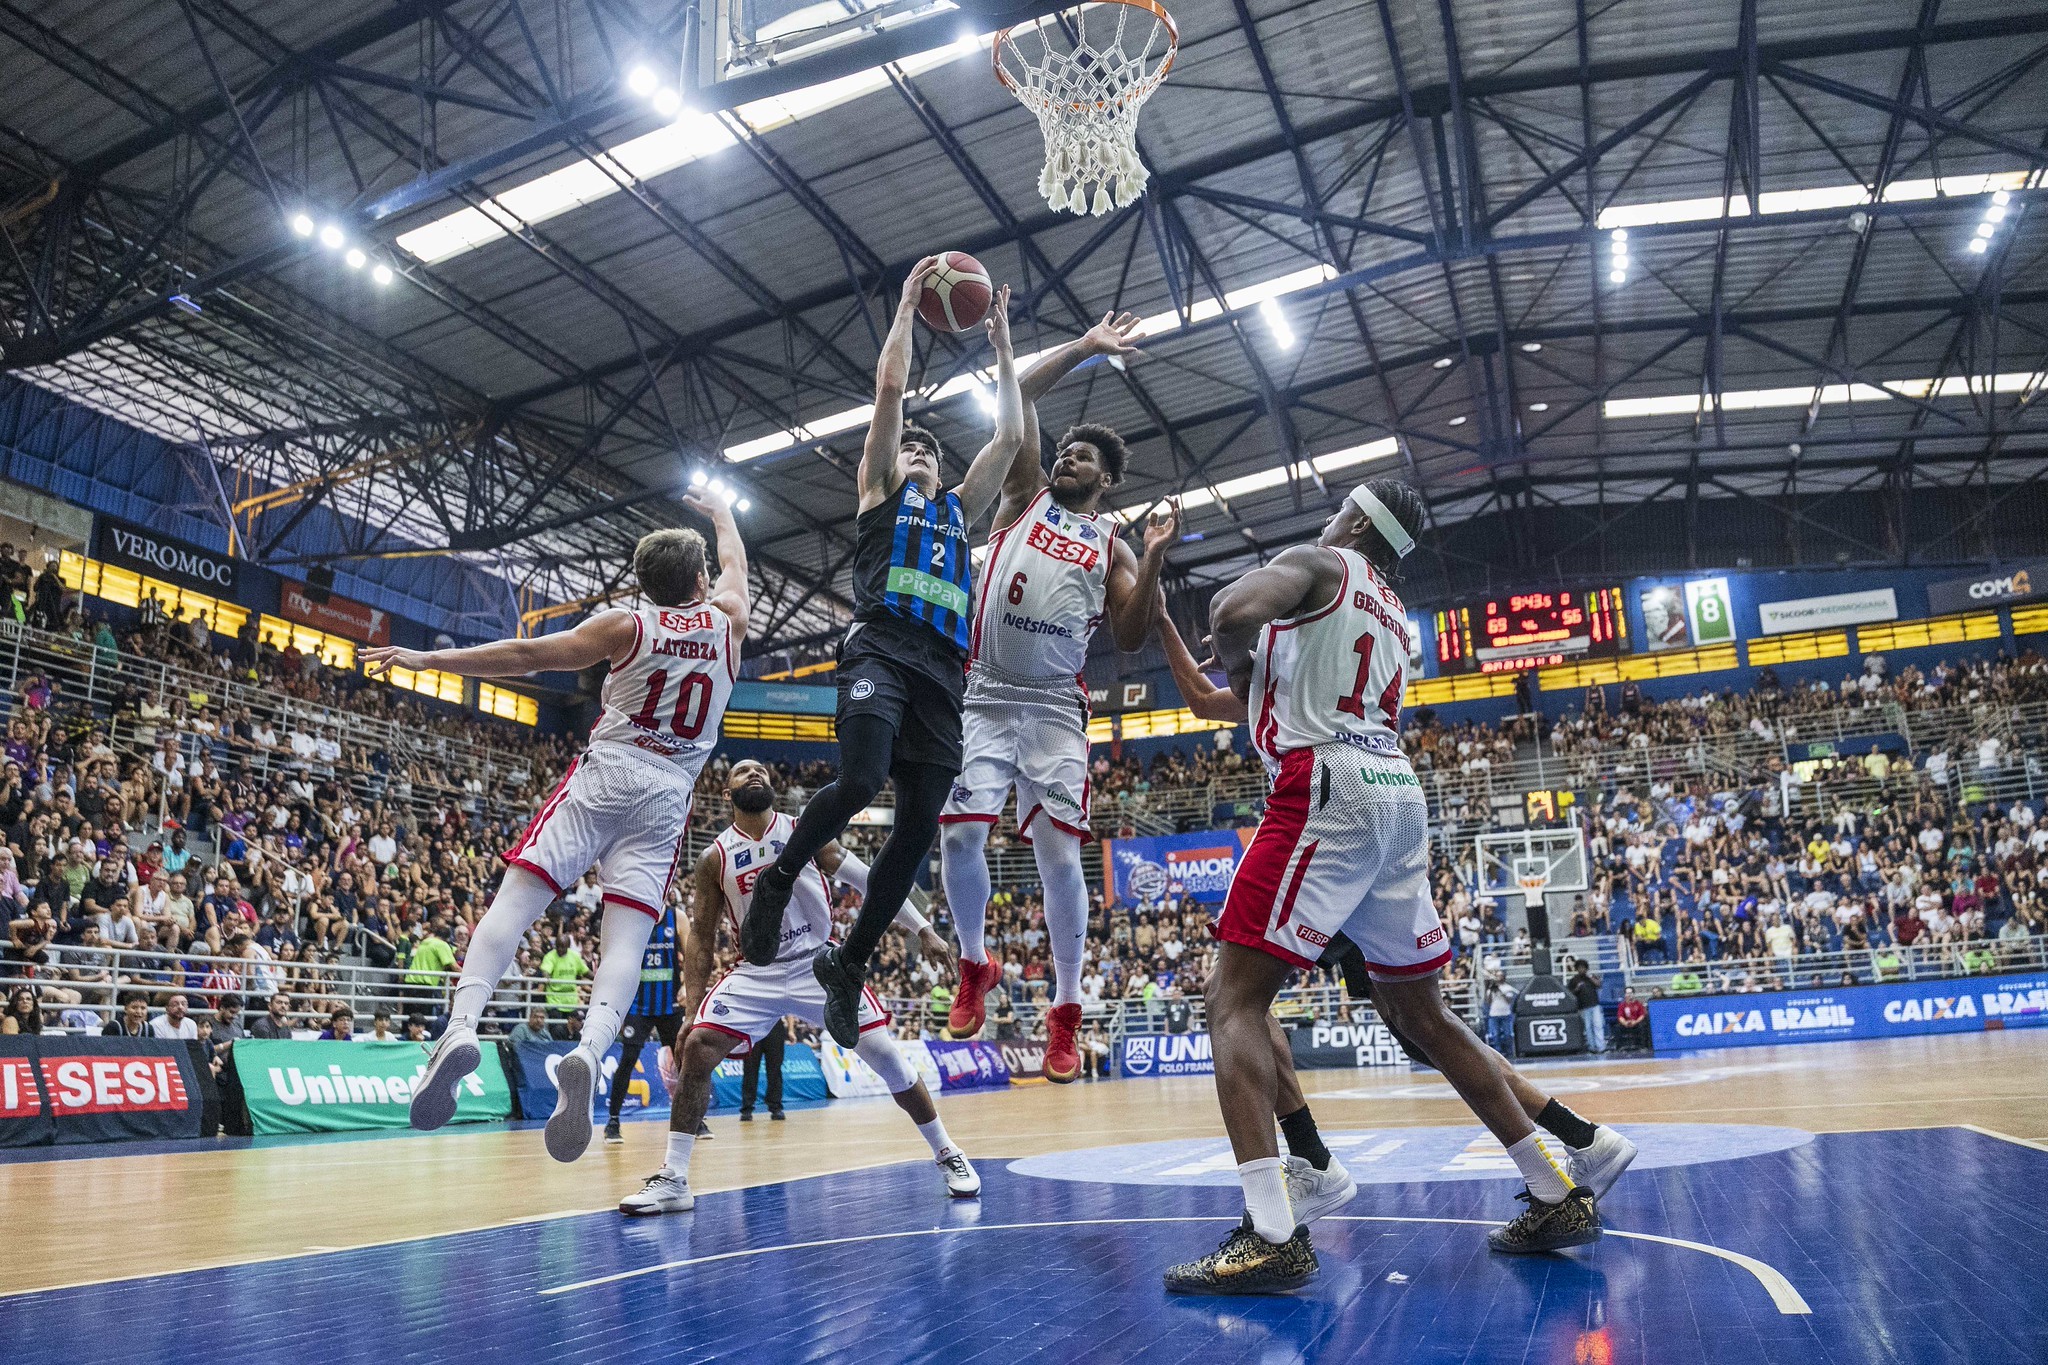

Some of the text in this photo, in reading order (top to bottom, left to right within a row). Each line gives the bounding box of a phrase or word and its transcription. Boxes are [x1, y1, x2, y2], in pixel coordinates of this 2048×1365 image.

[111, 528, 232, 587] VEROMOC
[930, 542, 946, 567] 2
[1033, 530, 1092, 565] SESI
[898, 571, 960, 609] PicPay
[1008, 571, 1028, 605] 6
[664, 611, 708, 632] SESI
[1702, 600, 1720, 622] 8
[1002, 611, 1073, 639] Netshoes
[651, 637, 718, 661] LATERZA
[1336, 631, 1402, 732] 14
[630, 668, 714, 741] 10
[1169, 857, 1235, 879] MAIOR
[1183, 875, 1232, 894] BRASI
[779, 922, 812, 943] tshoes
[1299, 926, 1329, 945] FIESP
[1419, 929, 1442, 948] SESI
[647, 953, 662, 966] 26
[1883, 988, 2048, 1023] CAIXA BRASI
[1675, 1004, 1855, 1036] CAIXA BRASIL
[1158, 1034, 1213, 1062] UNI
[1356, 1044, 1411, 1066] ADE
[1158, 1063, 1183, 1074] POLO
[57, 1060, 171, 1108] SESI
